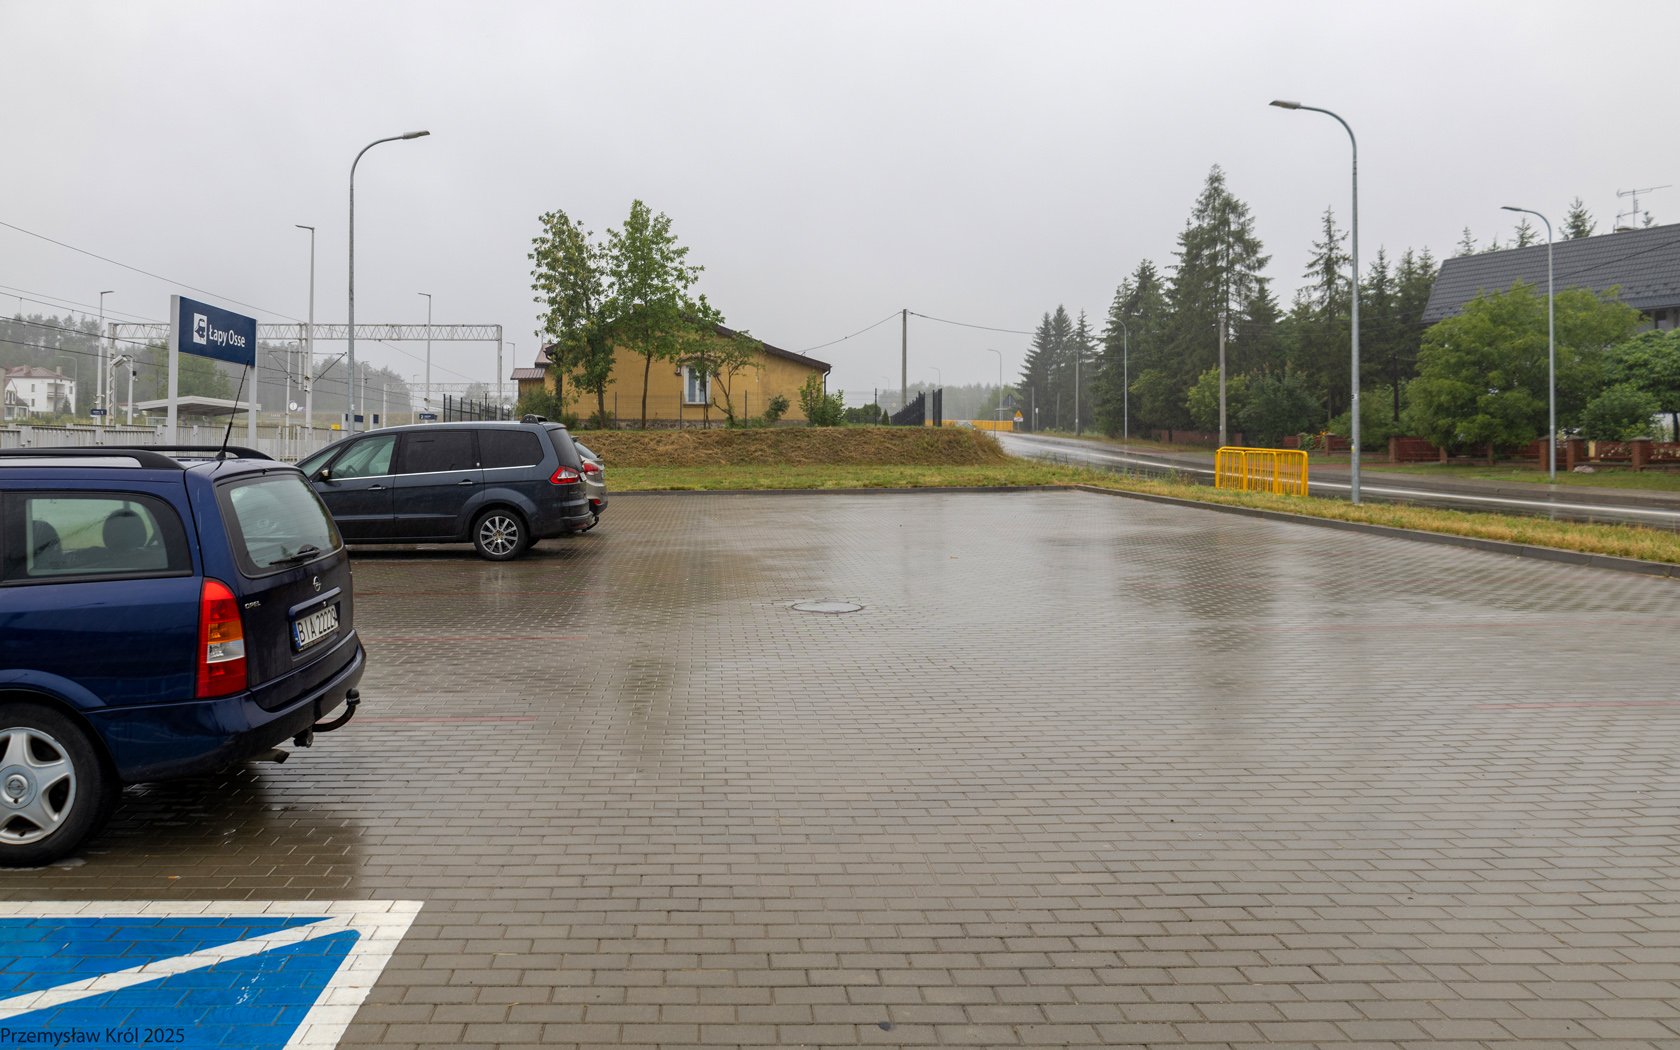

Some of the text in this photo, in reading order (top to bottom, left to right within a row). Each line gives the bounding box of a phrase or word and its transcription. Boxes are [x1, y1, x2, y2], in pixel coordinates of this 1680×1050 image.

[209, 324, 246, 347] Łapy Osse
[297, 617, 317, 643] BIA
